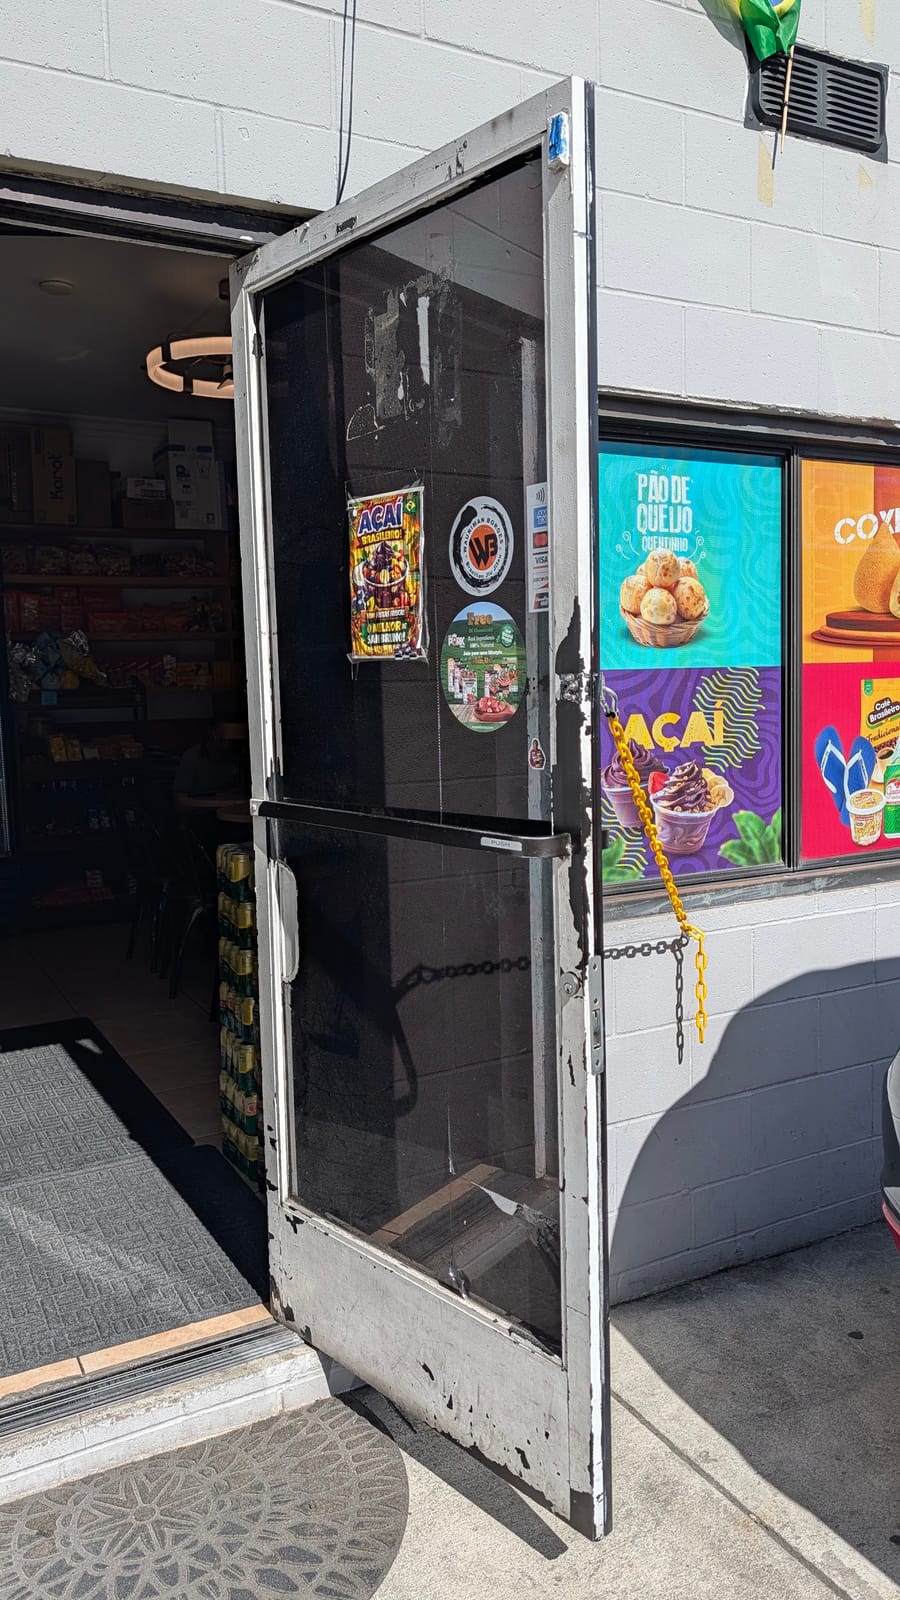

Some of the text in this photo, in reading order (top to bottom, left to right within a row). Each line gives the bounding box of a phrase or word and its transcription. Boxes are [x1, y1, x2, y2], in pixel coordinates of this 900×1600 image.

[637, 470, 692, 504] PÃO DE
[357, 496, 404, 536] AÇAÍ
[636, 503, 693, 534] QUEIJO
[361, 529, 403, 545] BRASILEIRO!
[372, 621, 402, 633] MELHOR
[467, 612, 494, 626] Free
[875, 698, 891, 711] Café
[869, 705, 900, 723] Brasileiro
[622, 700, 724, 752] AÇAÍ
[490, 839, 511, 848] PUSH
